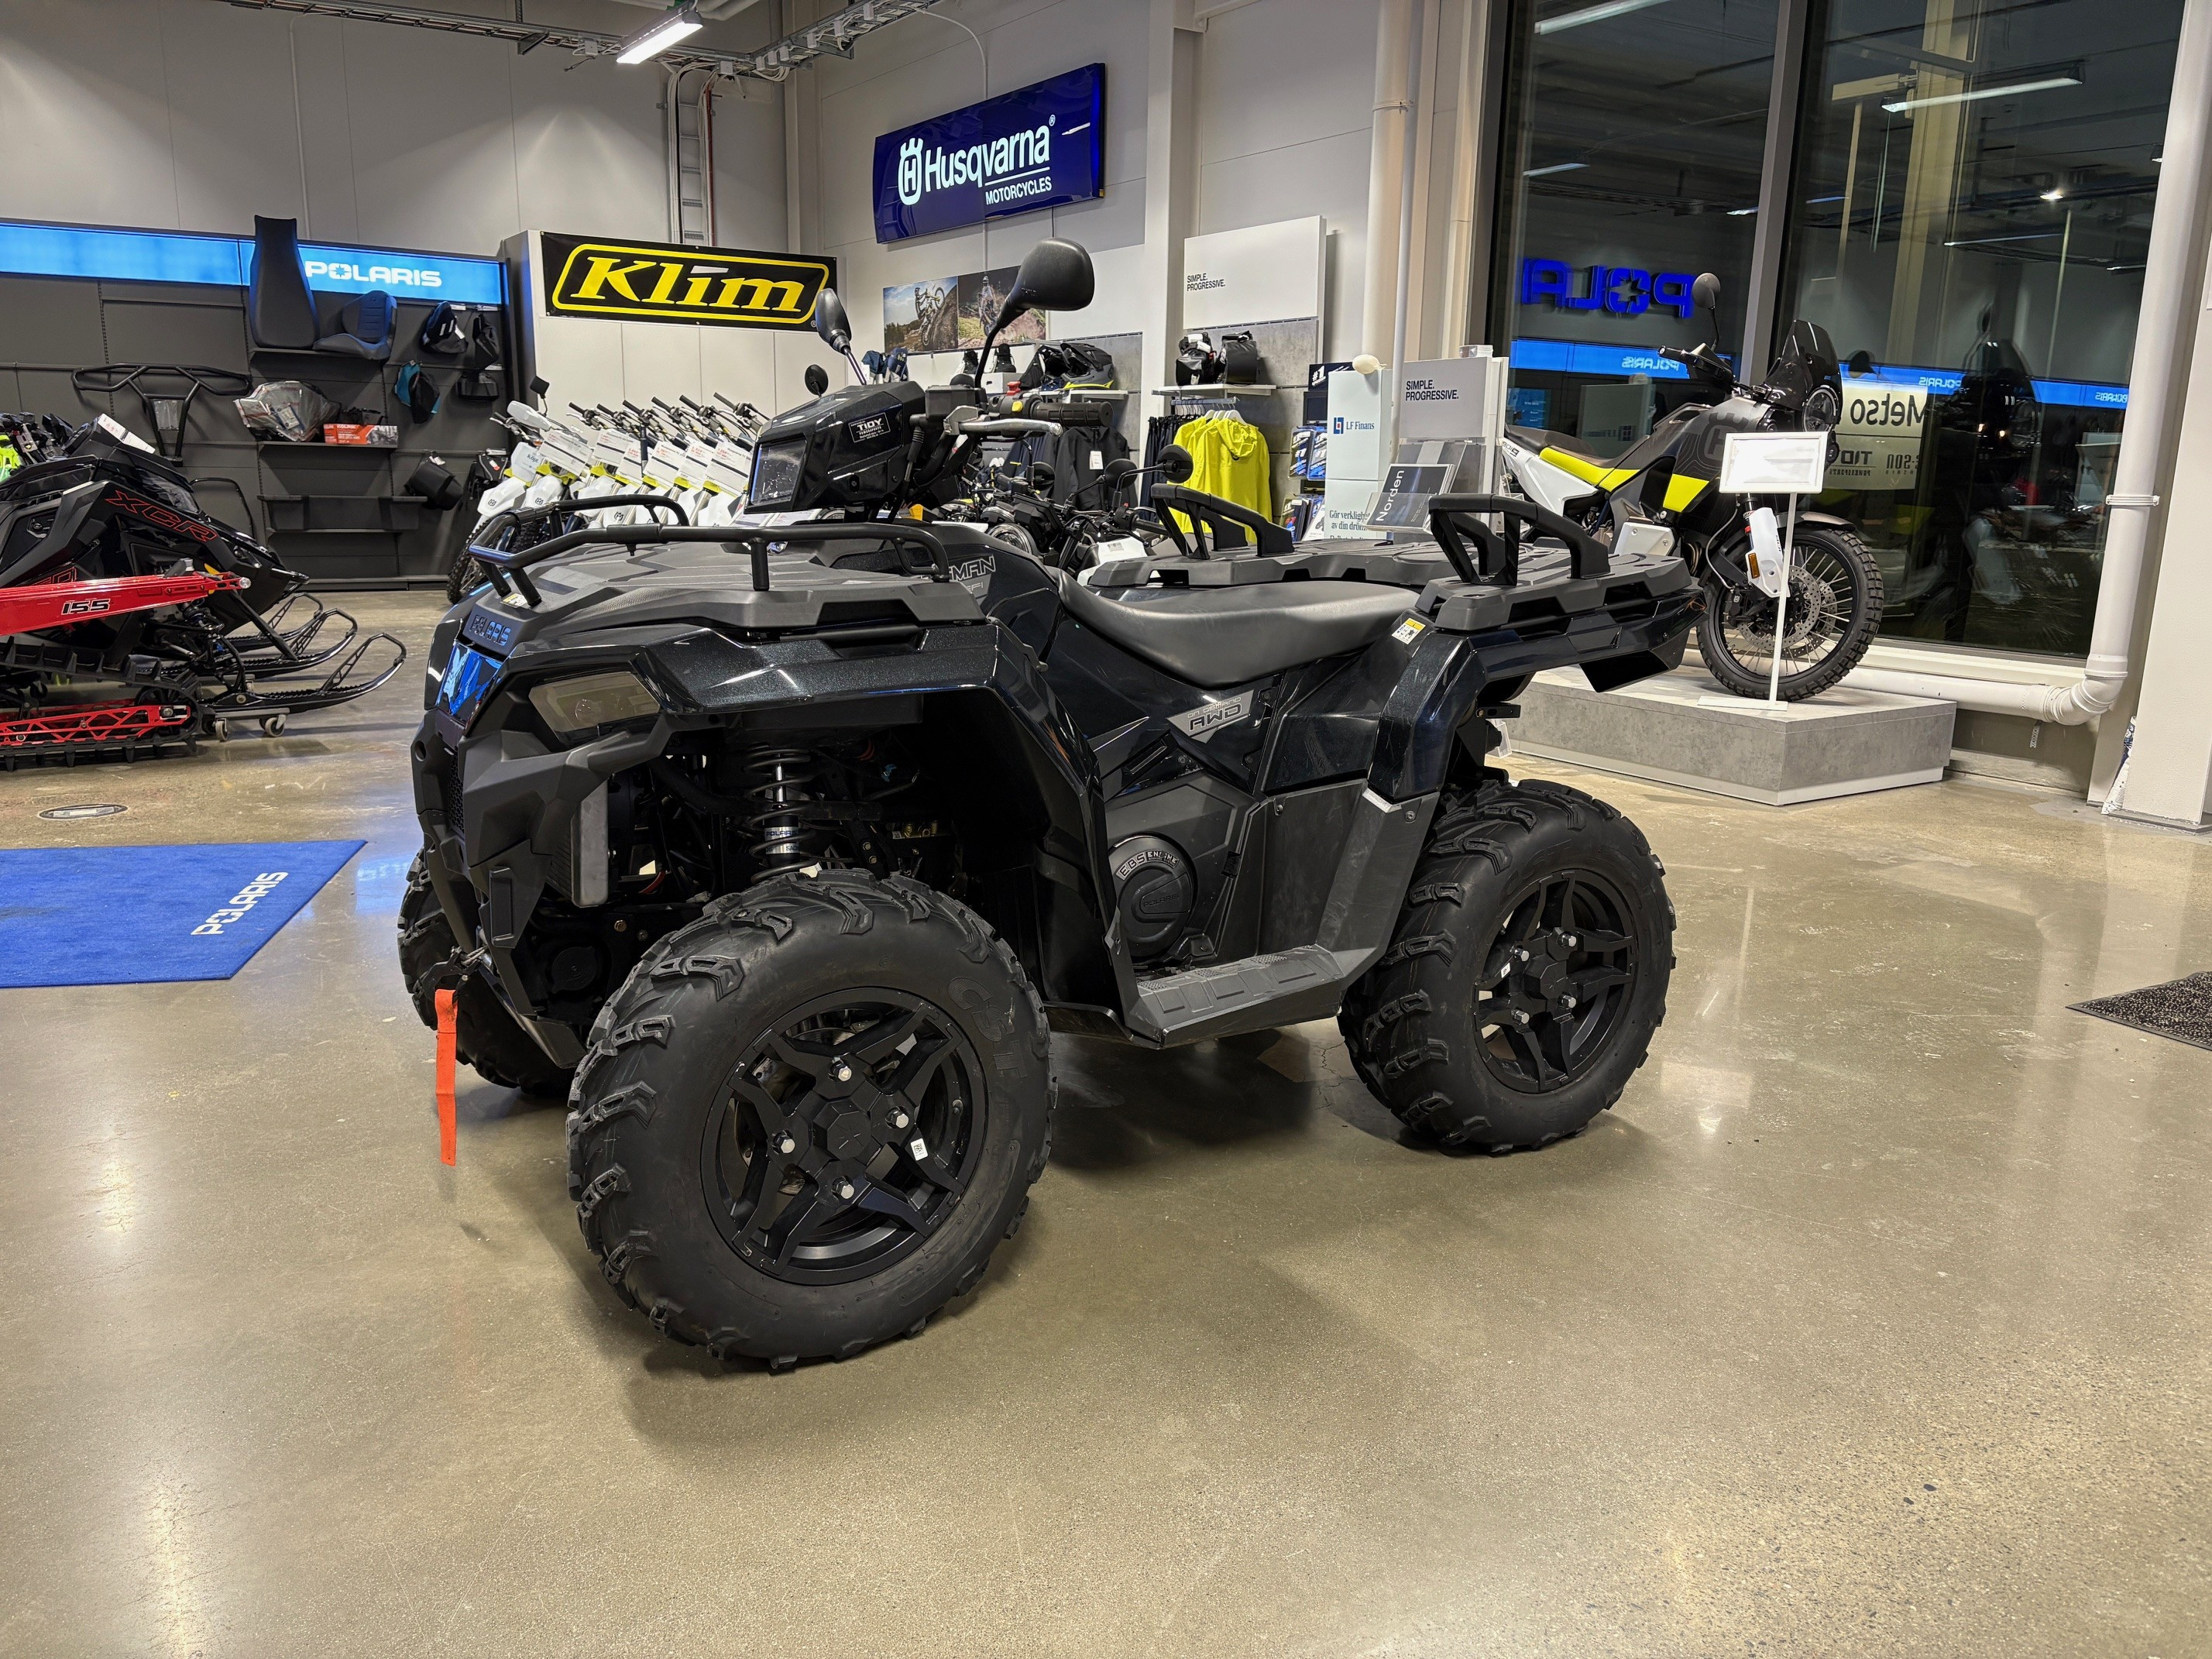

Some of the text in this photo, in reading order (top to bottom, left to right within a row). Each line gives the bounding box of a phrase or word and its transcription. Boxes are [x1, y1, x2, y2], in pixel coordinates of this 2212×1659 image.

[924, 124, 1051, 193] Husqvarna
[985, 176, 1053, 205] MOTORCYCLES
[304, 260, 443, 288] POLARIS
[1187, 273, 1208, 283] SIMPLE.
[1187, 279, 1226, 291] PROGRESSIVE.
[1405, 390, 1459, 401] PROGRESSIVE.
[1406, 380, 1434, 390] SIMPLE.
[857, 417, 882, 431] TIDY
[1346, 421, 1375, 430] LF Finans
[1376, 470, 1405, 521] Norden
[105, 489, 218, 542] XCR
[1329, 510, 1340, 519] Gör
[1338, 521, 1348, 530] din
[949, 554, 996, 582] MAN
[61, 598, 111, 615] 155
[1189, 702, 1242, 732] AWD
[1119, 851, 1146, 878] EBS
[190, 871, 290, 936] POLARIS
[947, 977, 1029, 1079] CST
